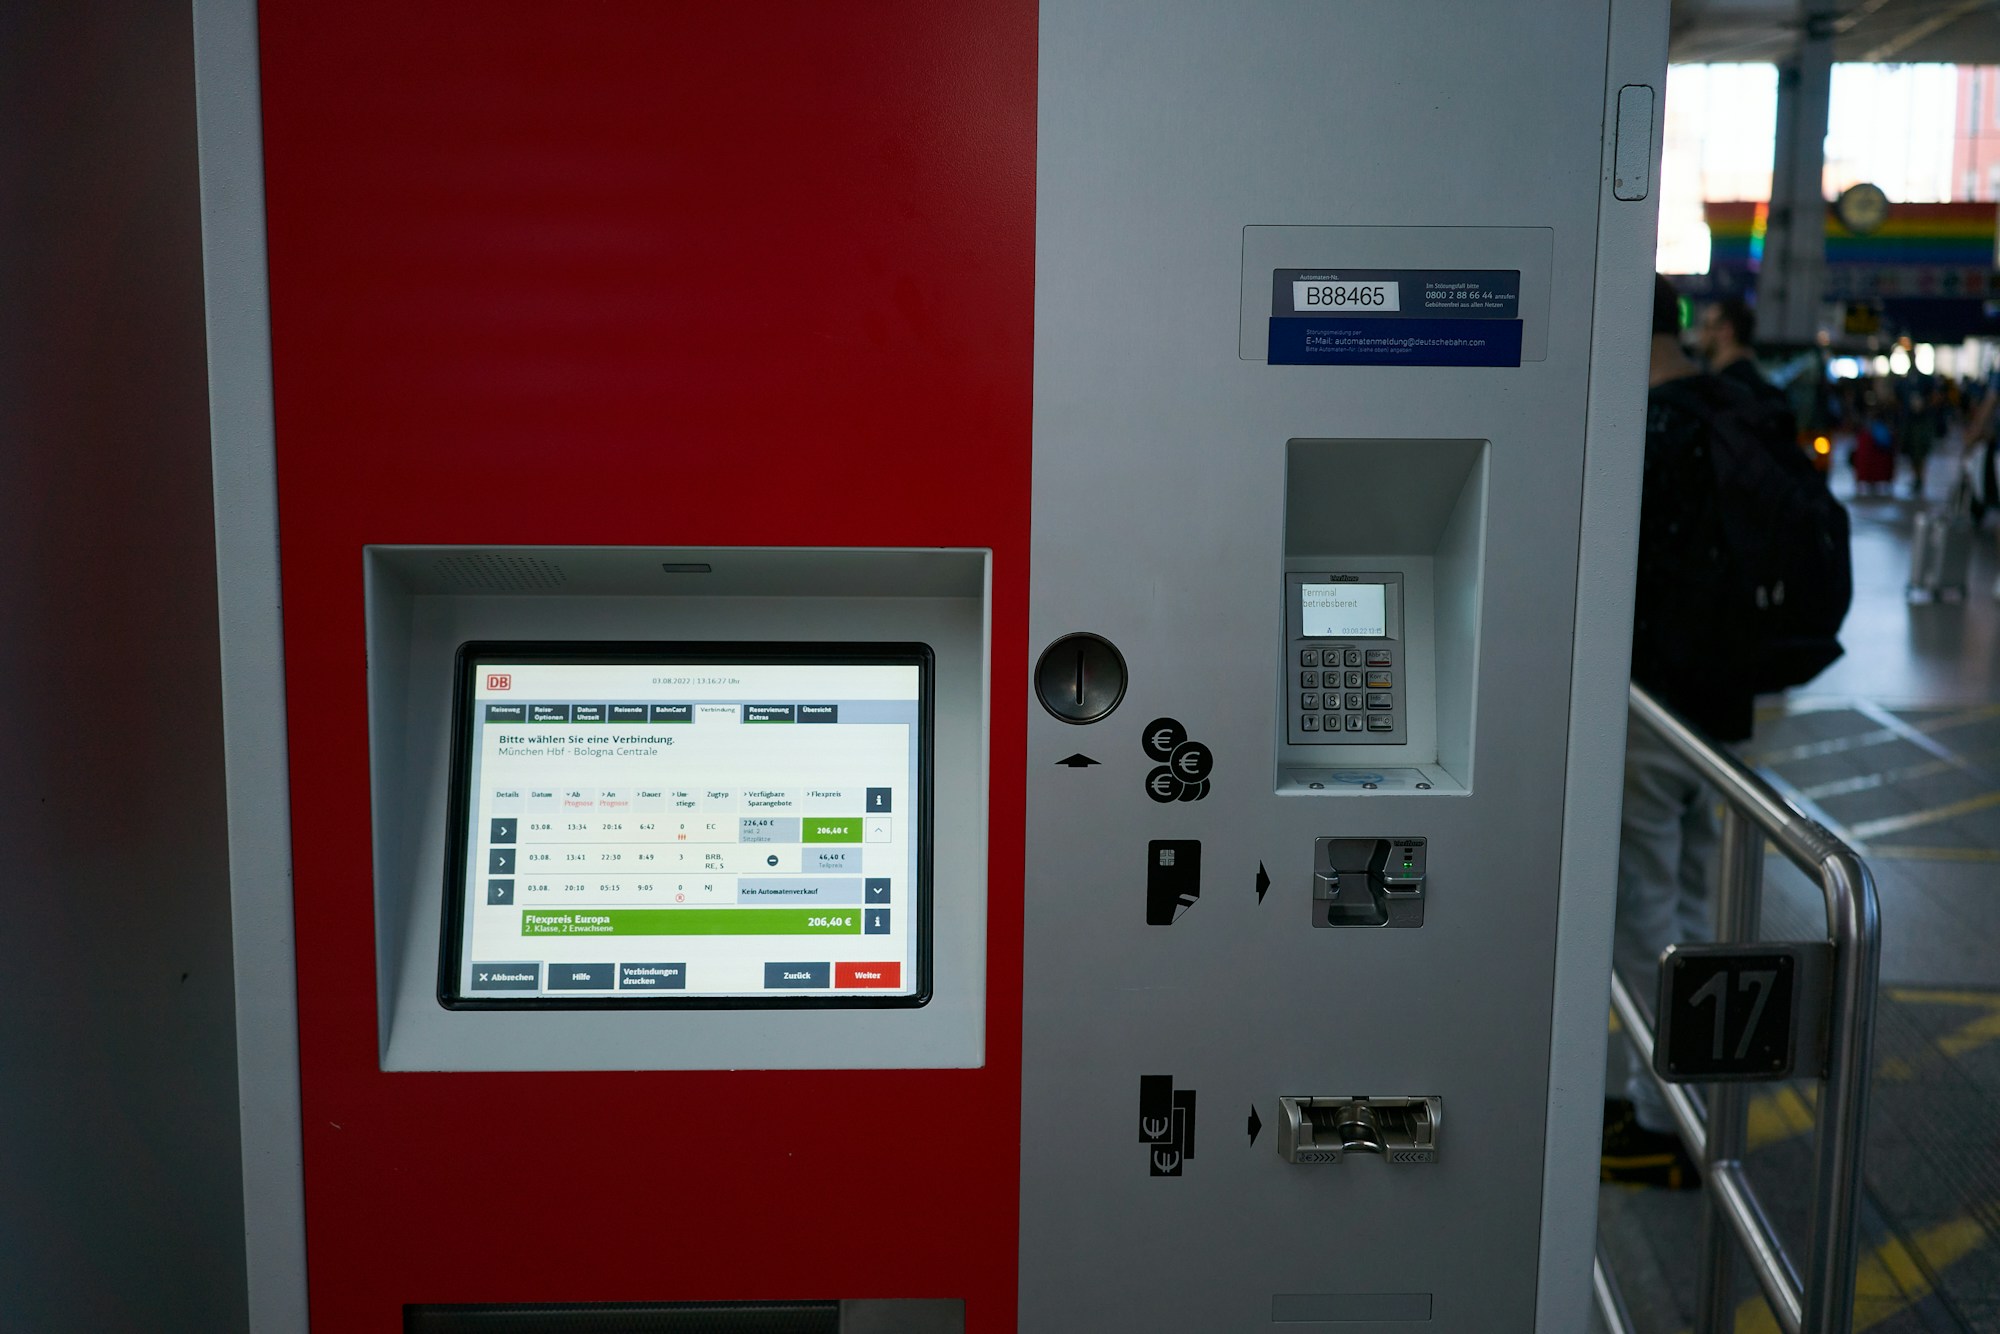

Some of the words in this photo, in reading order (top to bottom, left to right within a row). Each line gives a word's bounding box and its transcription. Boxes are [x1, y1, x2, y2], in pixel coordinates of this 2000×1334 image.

[1307, 286, 1384, 305] B88465
[1426, 291, 1446, 299] 0800
[1449, 291, 1454, 299] 2
[1456, 291, 1467, 299] 88
[1469, 291, 1480, 299] 66
[1482, 291, 1493, 299] 44
[1306, 337, 1333, 345] E-Mail:
[1335, 337, 1485, 347] automatenmeldung@deutschebahn.com
[1303, 588, 1337, 597] Terminal
[1302, 599, 1358, 608] betriebsbereit
[1307, 653, 1312, 663] 1
[1328, 653, 1335, 663] 2
[1350, 653, 1357, 663] 3
[489, 675, 509, 689] DB
[652, 677, 690, 685] 03.08.2022
[728, 677, 740, 685] Uhr
[1306, 674, 1314, 684] 4
[1328, 674, 1336, 684] 5
[1350, 674, 1358, 684] 6
[1307, 695, 1315, 706] 7
[1329, 696, 1336, 707] 8
[1350, 696, 1358, 706] 9
[1329, 717, 1337, 728] 0
[499, 735, 525, 744] Bitte
[528, 735, 565, 744] wählen
[568, 735, 584, 744] Sie
[587, 735, 609, 744] eine
[612, 735, 675, 745] Verbindung.
[498, 747, 544, 756] München
[547, 747, 564, 756] Hbf
[574, 748, 614, 757] Bologna
[617, 748, 658, 756] Centrale
[564, 800, 593, 808] Prognose
[600, 800, 629, 808] Prognose
[676, 800, 696, 808] stiege
[526, 915, 572, 925] Flexpreis
[575, 915, 610, 925] Europa
[808, 918, 842, 927] 206,40
[844, 918, 852, 926] €
[534, 925, 561, 933] Klasse,
[491, 973, 534, 982] Abbrechen
[572, 973, 591, 981] Hilfe
[623, 968, 678, 977] Verbindungen
[783, 971, 811, 980] Zurück
[623, 977, 655, 985] drucken
[1688, 971, 1778, 1060] 17
